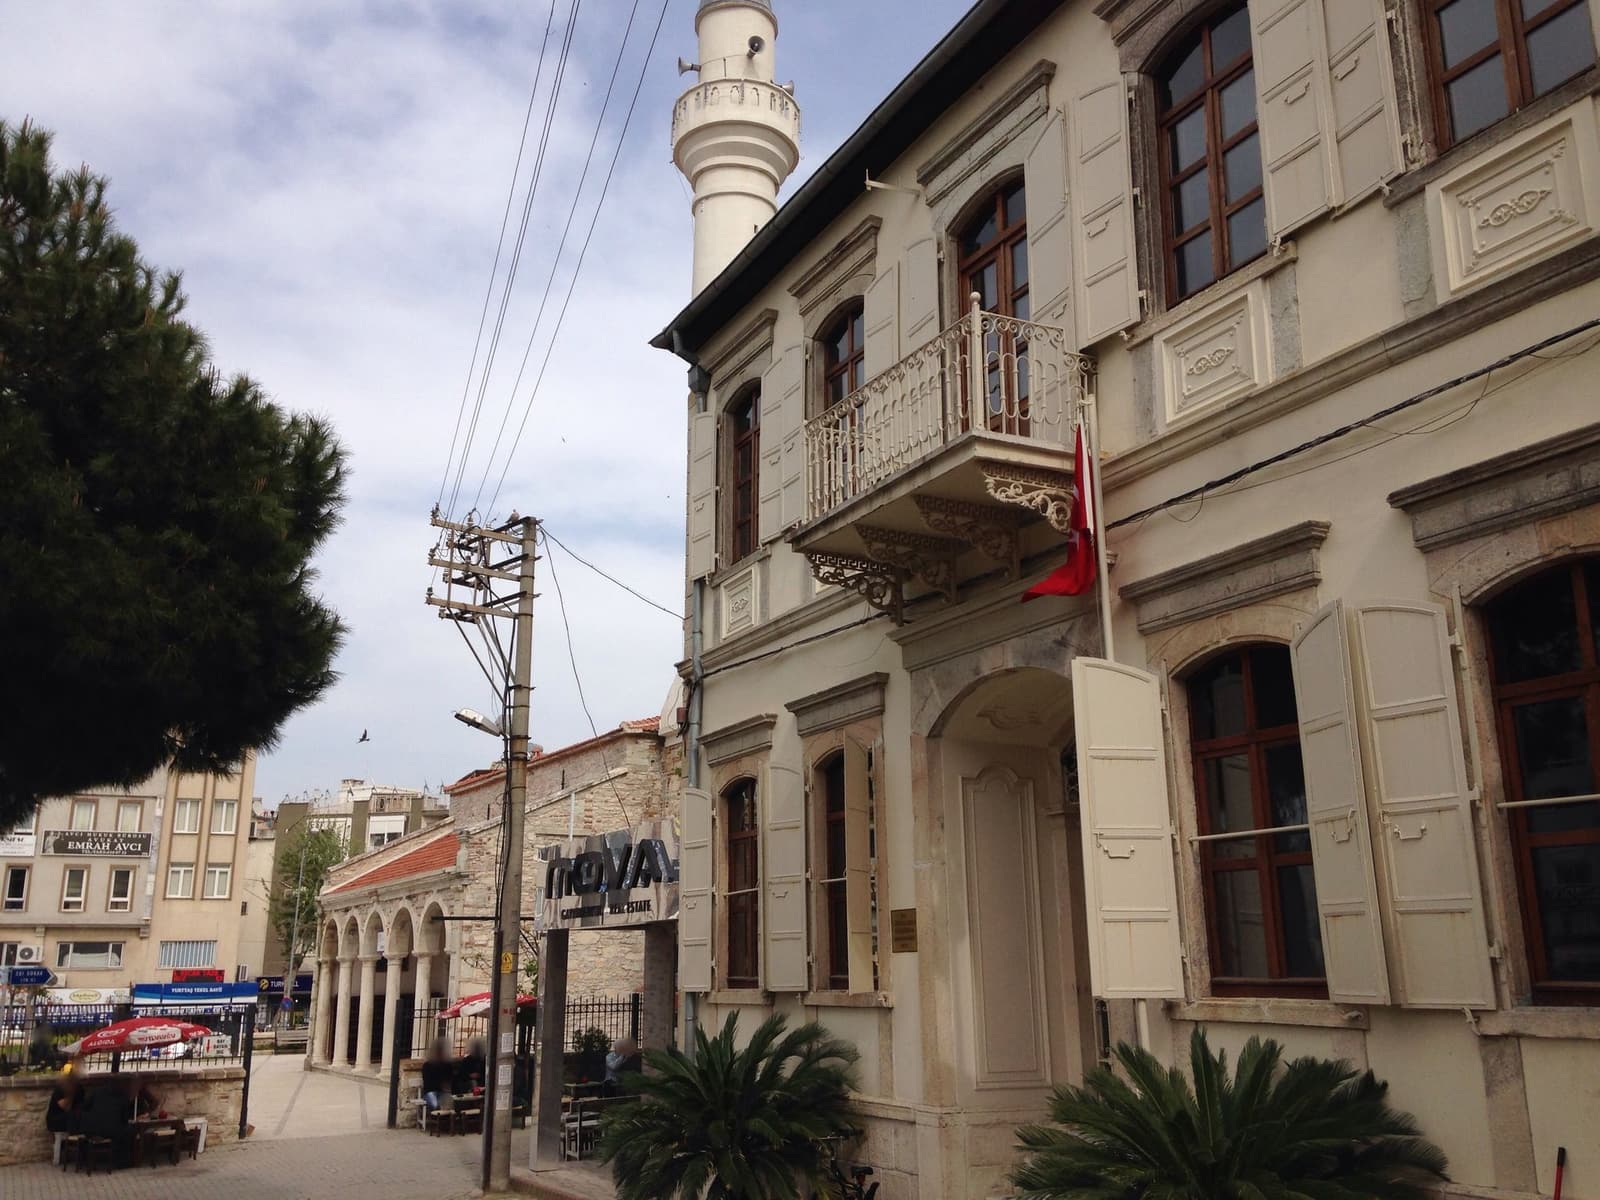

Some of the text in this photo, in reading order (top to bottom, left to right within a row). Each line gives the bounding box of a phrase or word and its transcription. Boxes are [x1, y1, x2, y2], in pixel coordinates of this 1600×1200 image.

[67, 841, 142, 851] EMRAH AVCI
[627, 900, 651, 914] ESTATE
